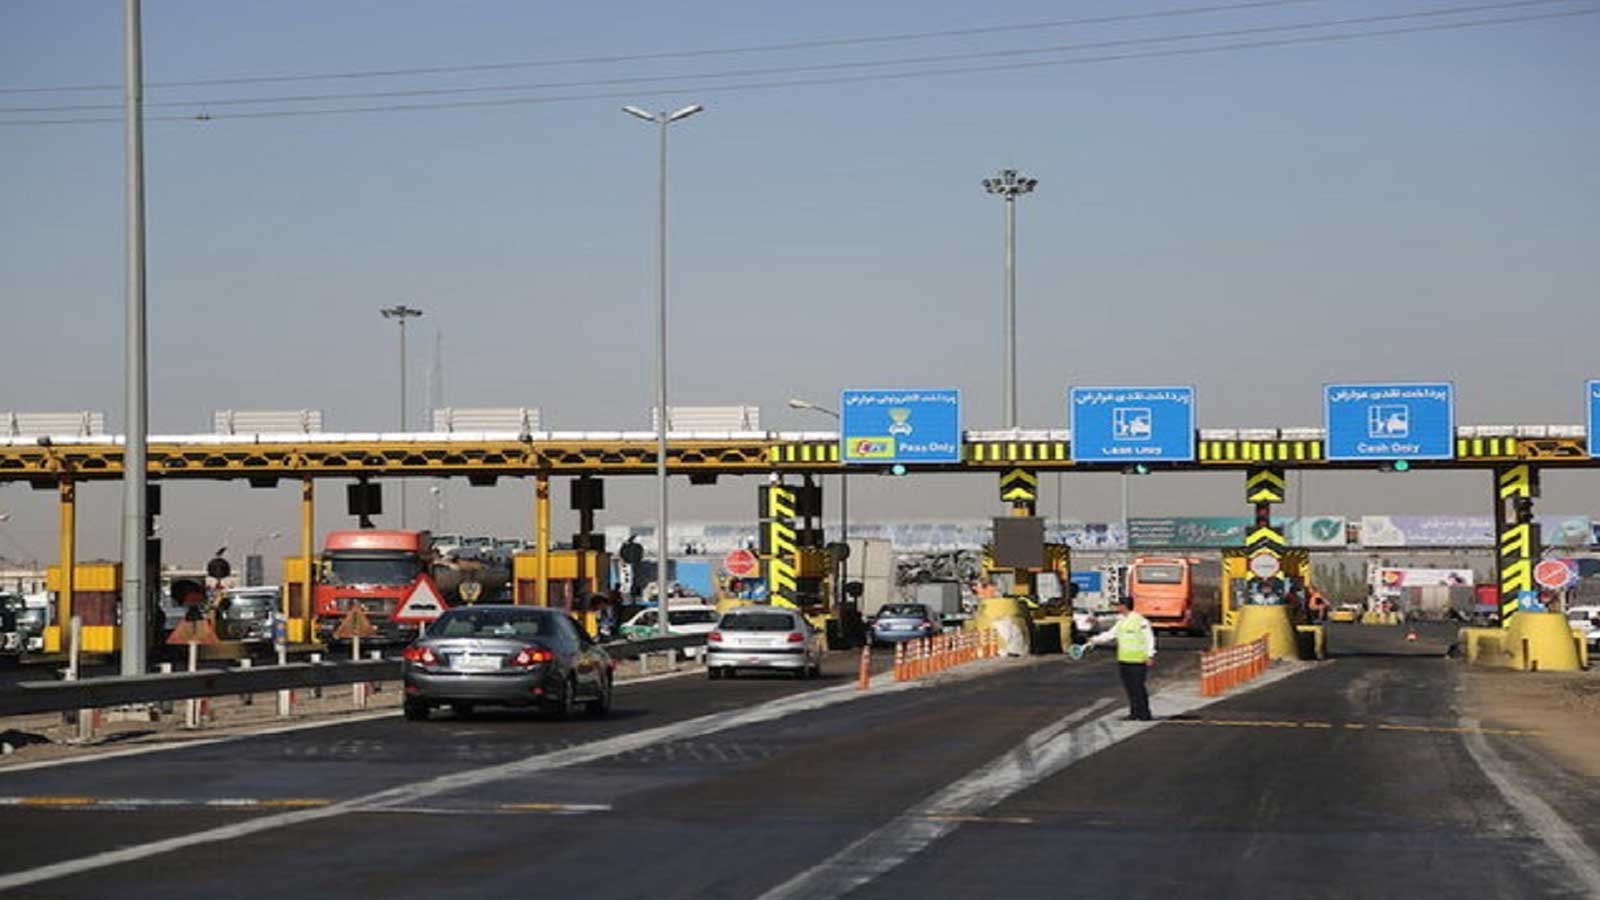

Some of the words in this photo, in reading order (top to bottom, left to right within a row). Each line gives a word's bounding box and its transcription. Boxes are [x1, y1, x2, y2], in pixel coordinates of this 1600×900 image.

[1402, 388, 1446, 401] پرداخت
[899, 443, 926, 453] Pass
[928, 441, 956, 454] Only
[1356, 442, 1389, 454] Cash
[1391, 442, 1421, 454] Only
